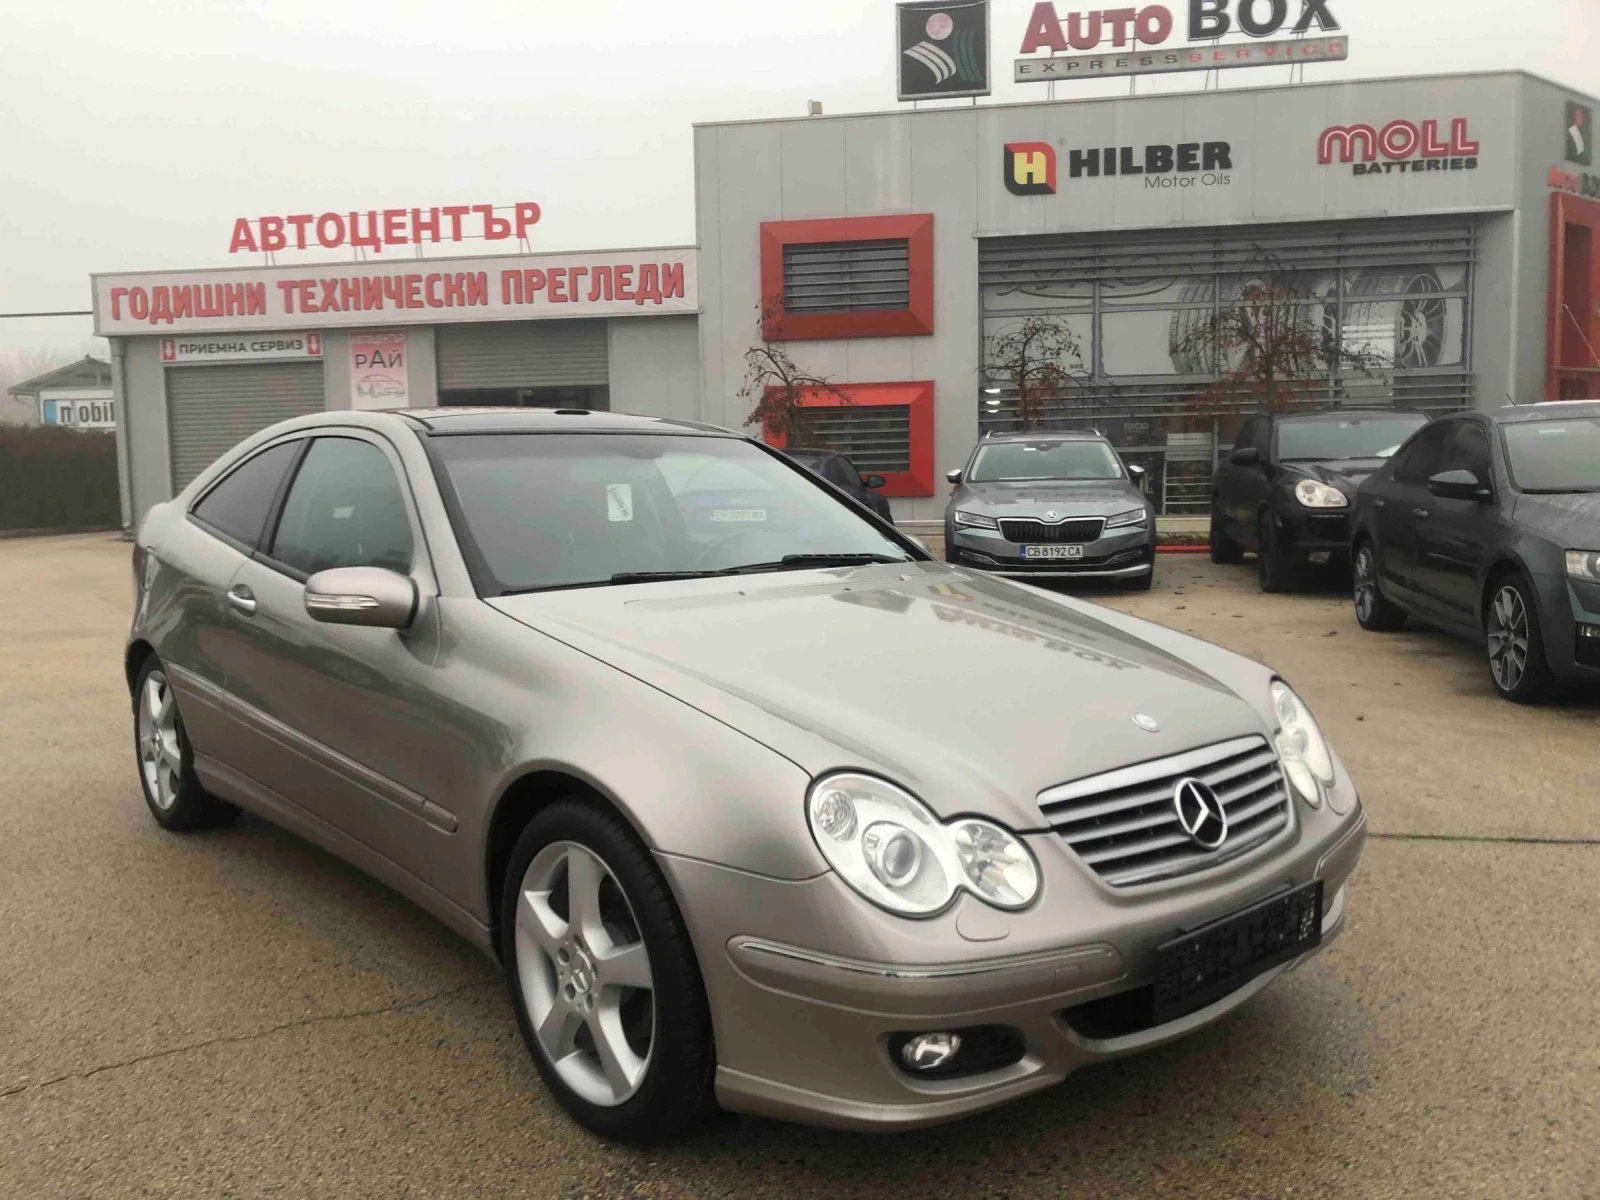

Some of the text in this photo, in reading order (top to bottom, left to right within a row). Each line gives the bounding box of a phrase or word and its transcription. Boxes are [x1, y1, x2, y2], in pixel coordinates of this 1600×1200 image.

[1019, 0, 1342, 54] AUTO BOX
[1069, 141, 1233, 178] HILBER
[1352, 157, 1478, 176] BATTERIES
[1144, 172, 1231, 189] Motor Oils
[229, 202, 541, 253] АВТОЦЕНТЪР
[111, 262, 685, 325] ГОДИШНИ ТЕХНИЧЕСКИ ПРЕГЛЕДИ
[179, 339, 304, 355] ПРИЕМНА СЕРВИЗ
[355, 349, 403, 369] РАЙ
